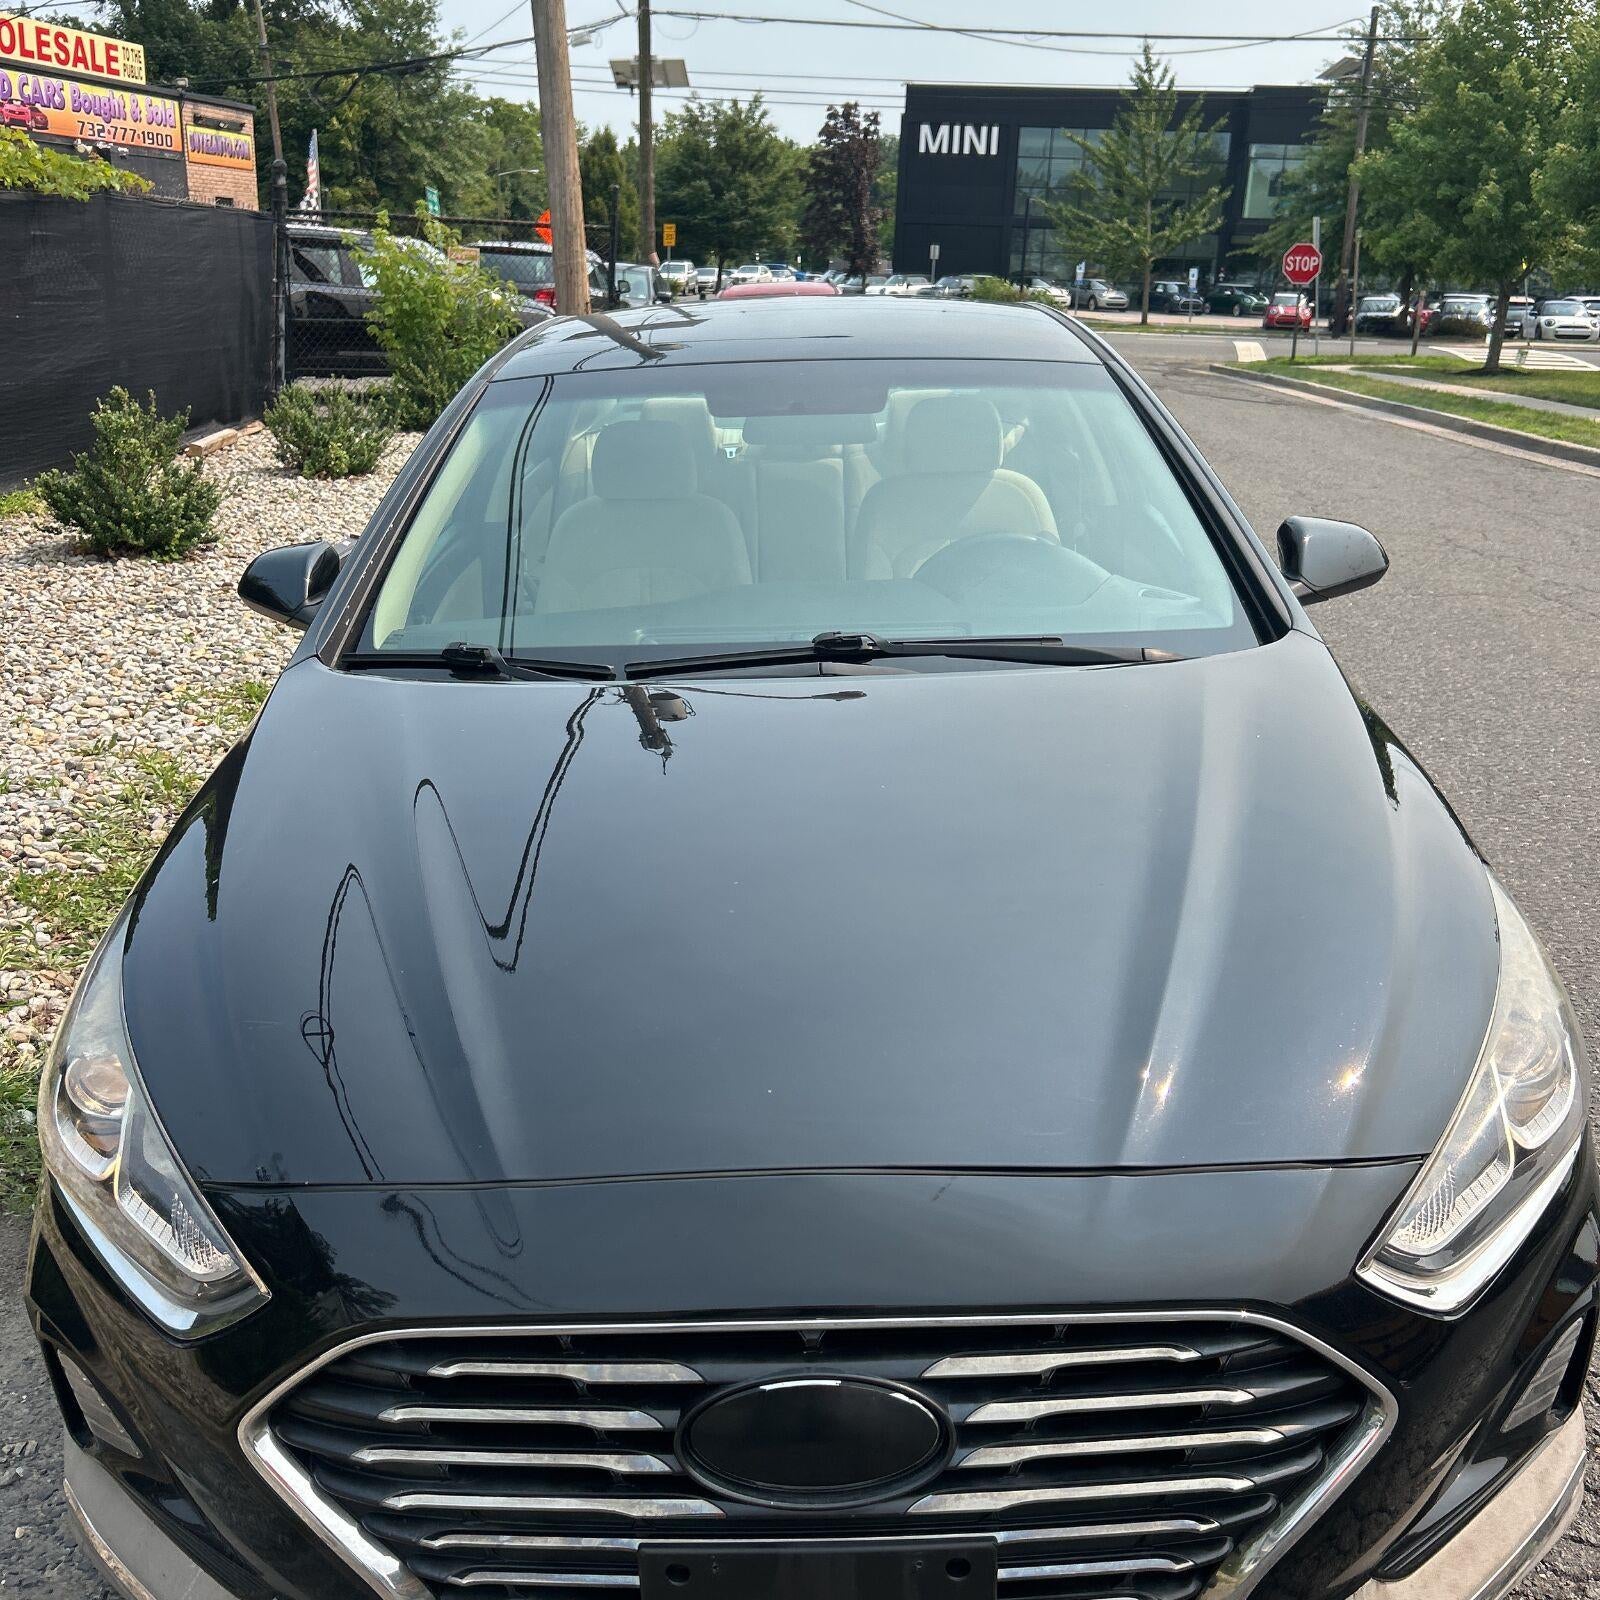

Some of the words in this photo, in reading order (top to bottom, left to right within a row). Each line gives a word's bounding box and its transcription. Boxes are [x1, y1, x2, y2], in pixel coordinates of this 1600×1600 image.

[0, 18, 120, 77] OLESALE
[122, 46, 131, 62] TO
[130, 48, 142, 64] THE
[123, 63, 143, 81] PUBLIC
[18, 74, 66, 110] CARS
[69, 82, 127, 124] Bought
[130, 94, 142, 123] &
[146, 97, 176, 128] Sold
[919, 124, 1000, 156] MINI
[1285, 256, 1319, 272] STOP
